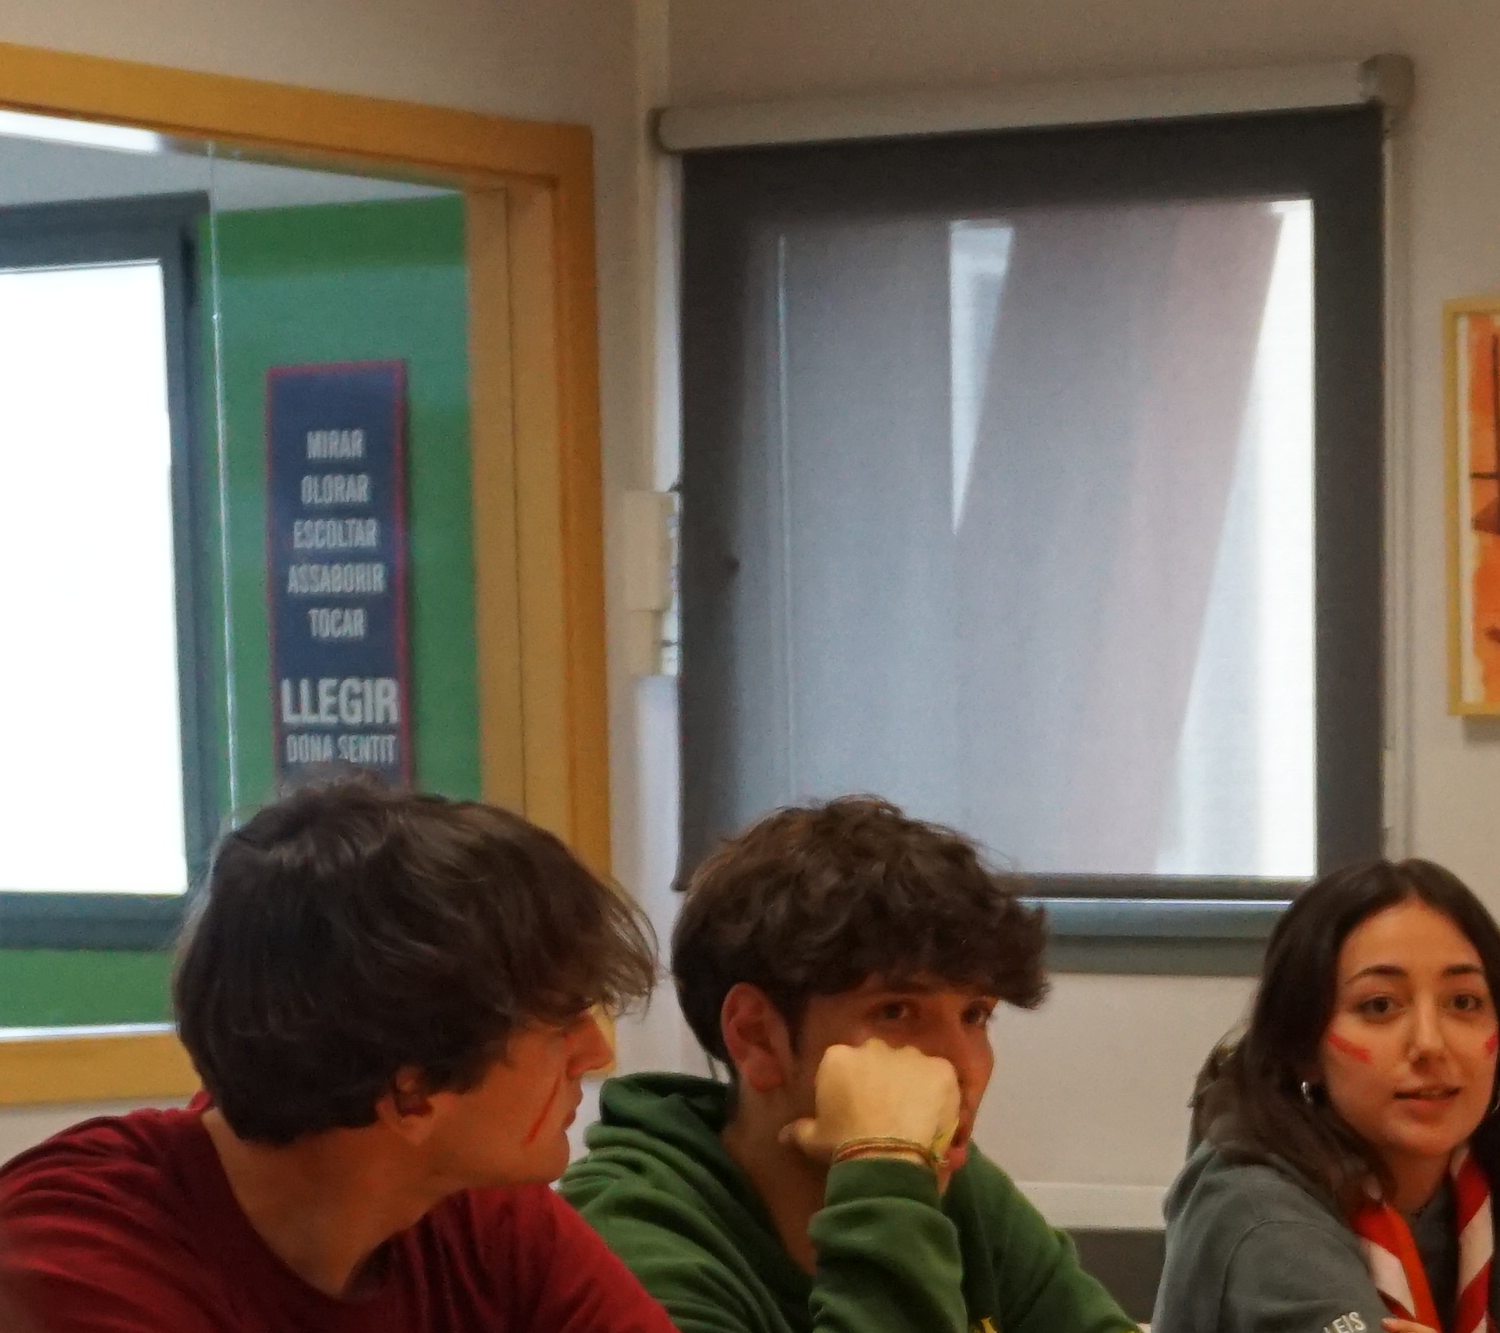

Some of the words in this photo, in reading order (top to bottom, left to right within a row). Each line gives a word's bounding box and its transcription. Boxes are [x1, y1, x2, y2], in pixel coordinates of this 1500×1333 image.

[306, 429, 364, 459] MIRAR
[301, 474, 369, 503] OLORAR
[293, 519, 377, 549] ESCOLTAR
[288, 563, 386, 593] ASSABORIR
[308, 608, 365, 638] TOCAR
[280, 678, 399, 725] LLEGIR
[286, 733, 332, 763] DONA
[338, 733, 395, 763] SENTIT
